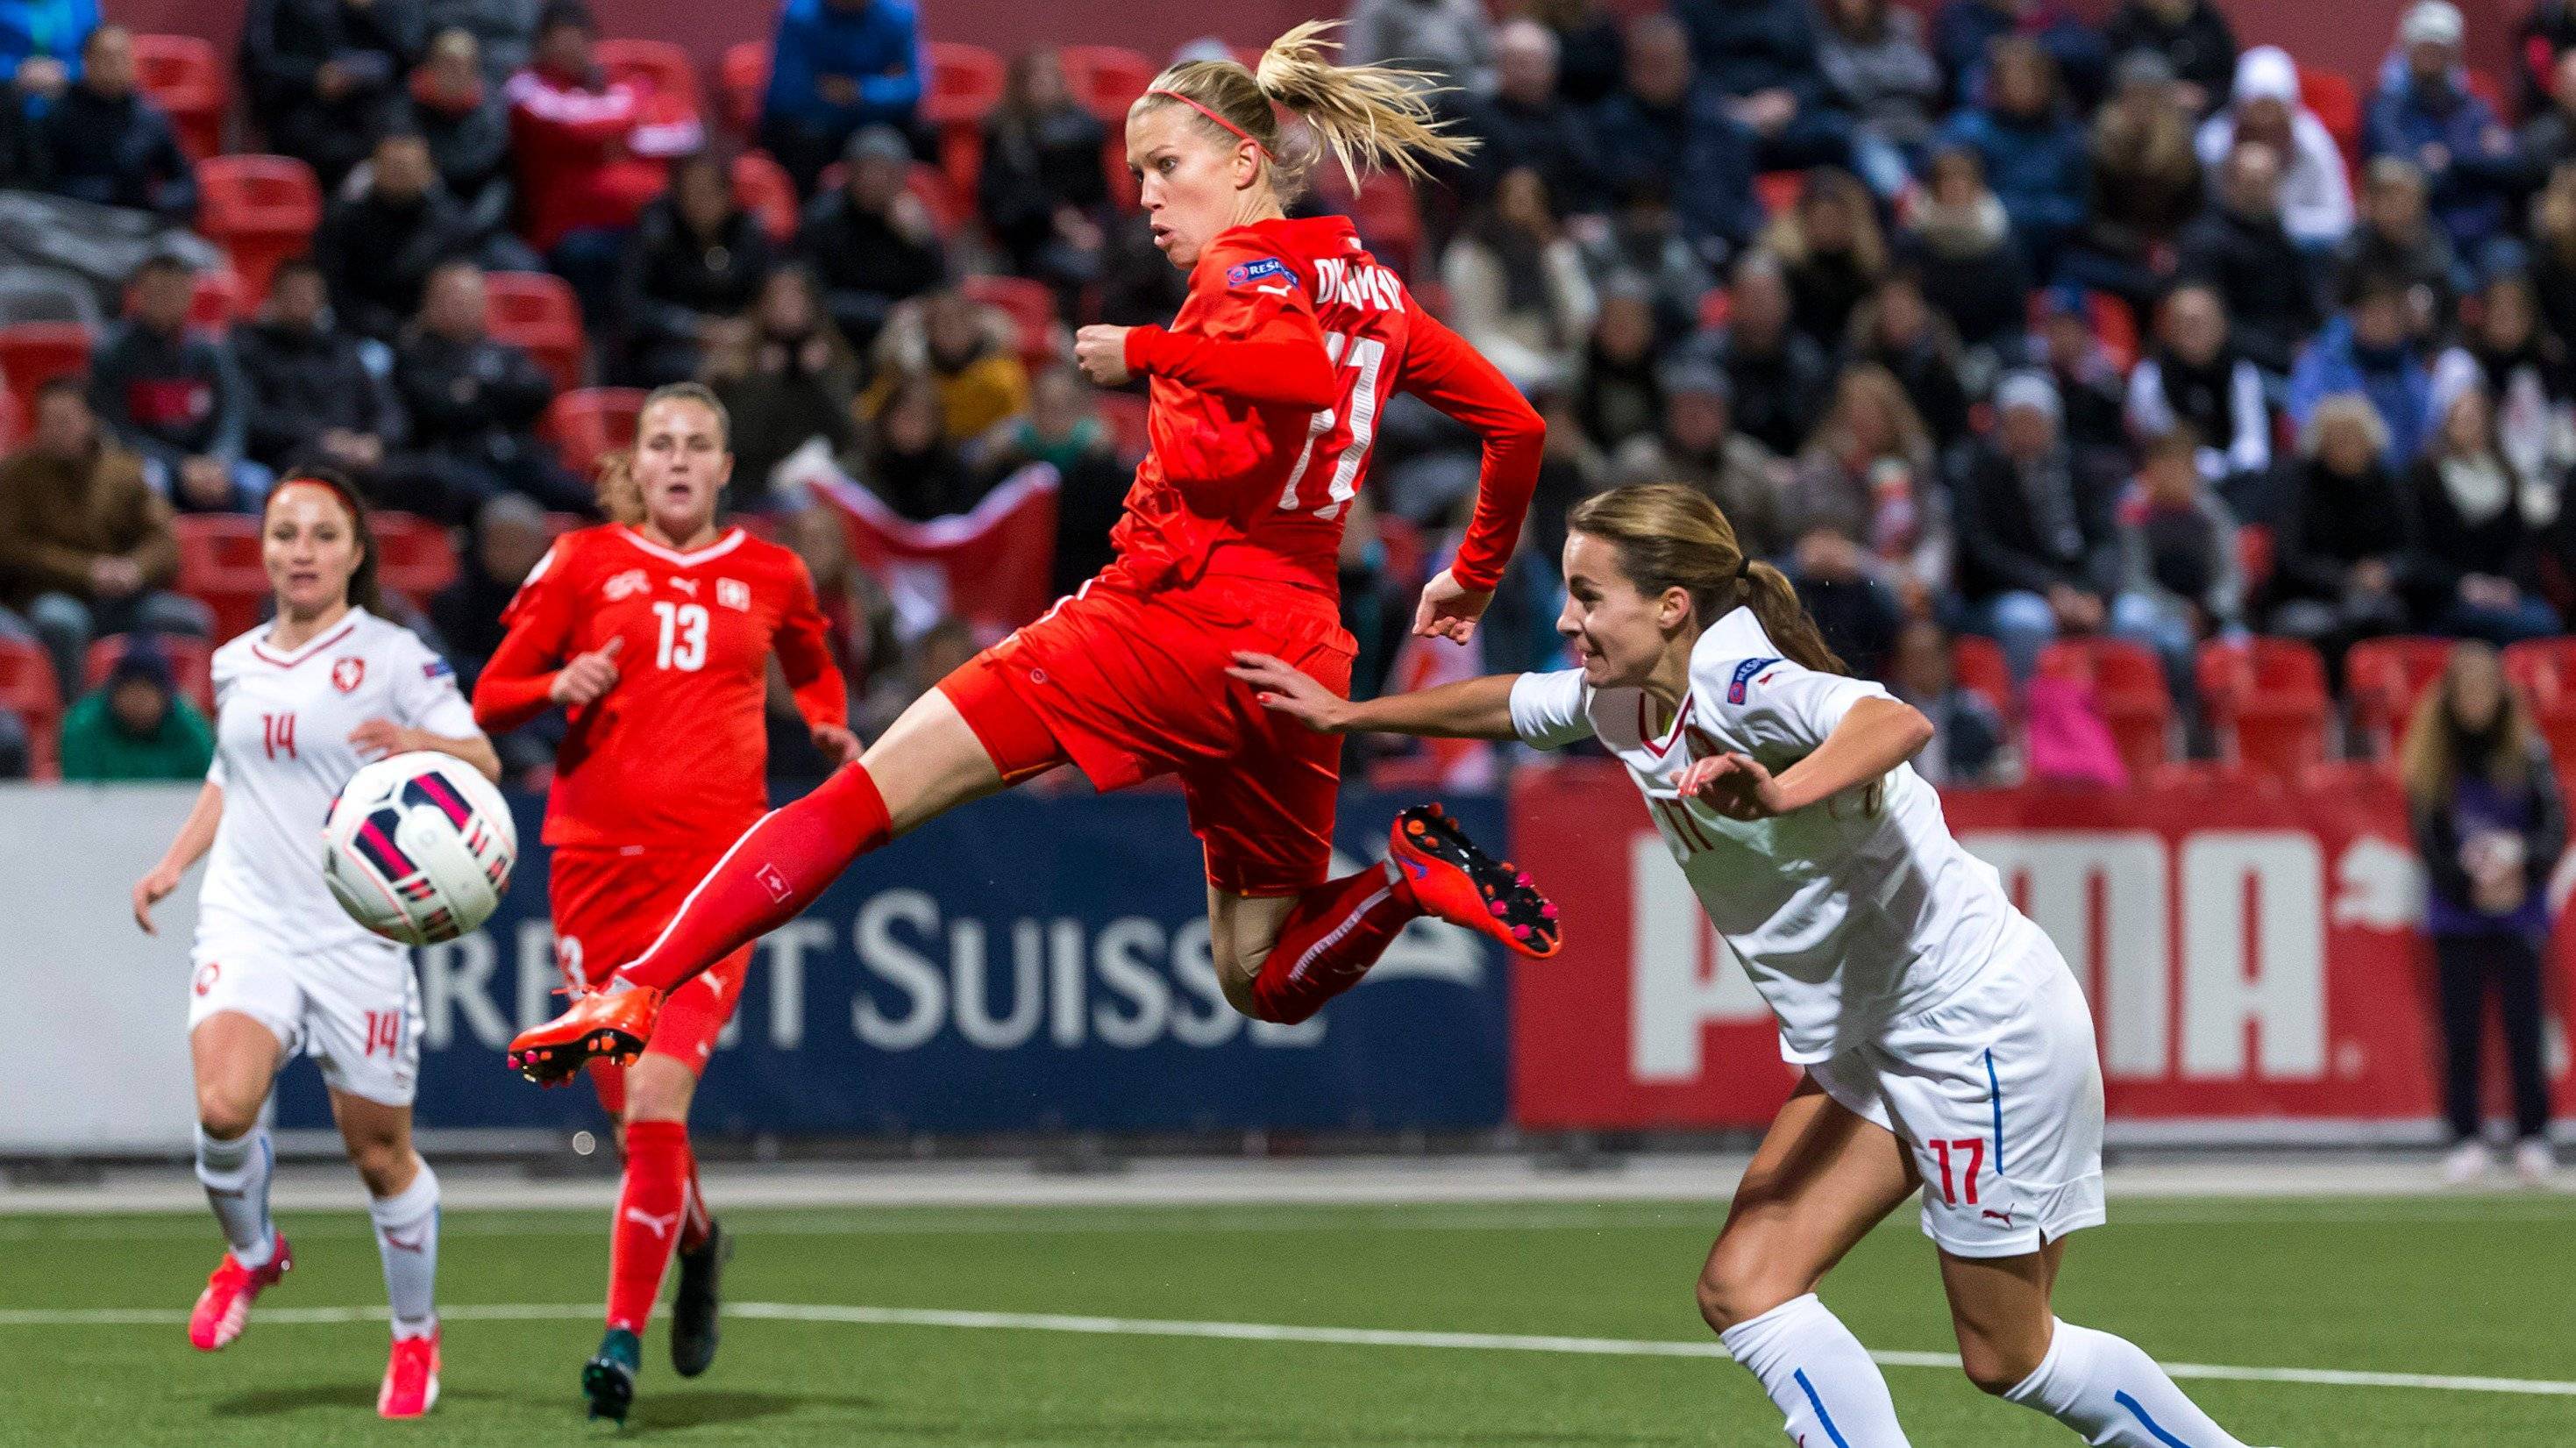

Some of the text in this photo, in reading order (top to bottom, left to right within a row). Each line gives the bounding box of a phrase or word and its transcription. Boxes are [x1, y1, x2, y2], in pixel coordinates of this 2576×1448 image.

[652, 601, 709, 672] 13
[263, 713, 298, 760] 14
[364, 1009, 399, 1059] 14
[1929, 1138, 1983, 1205] 17
